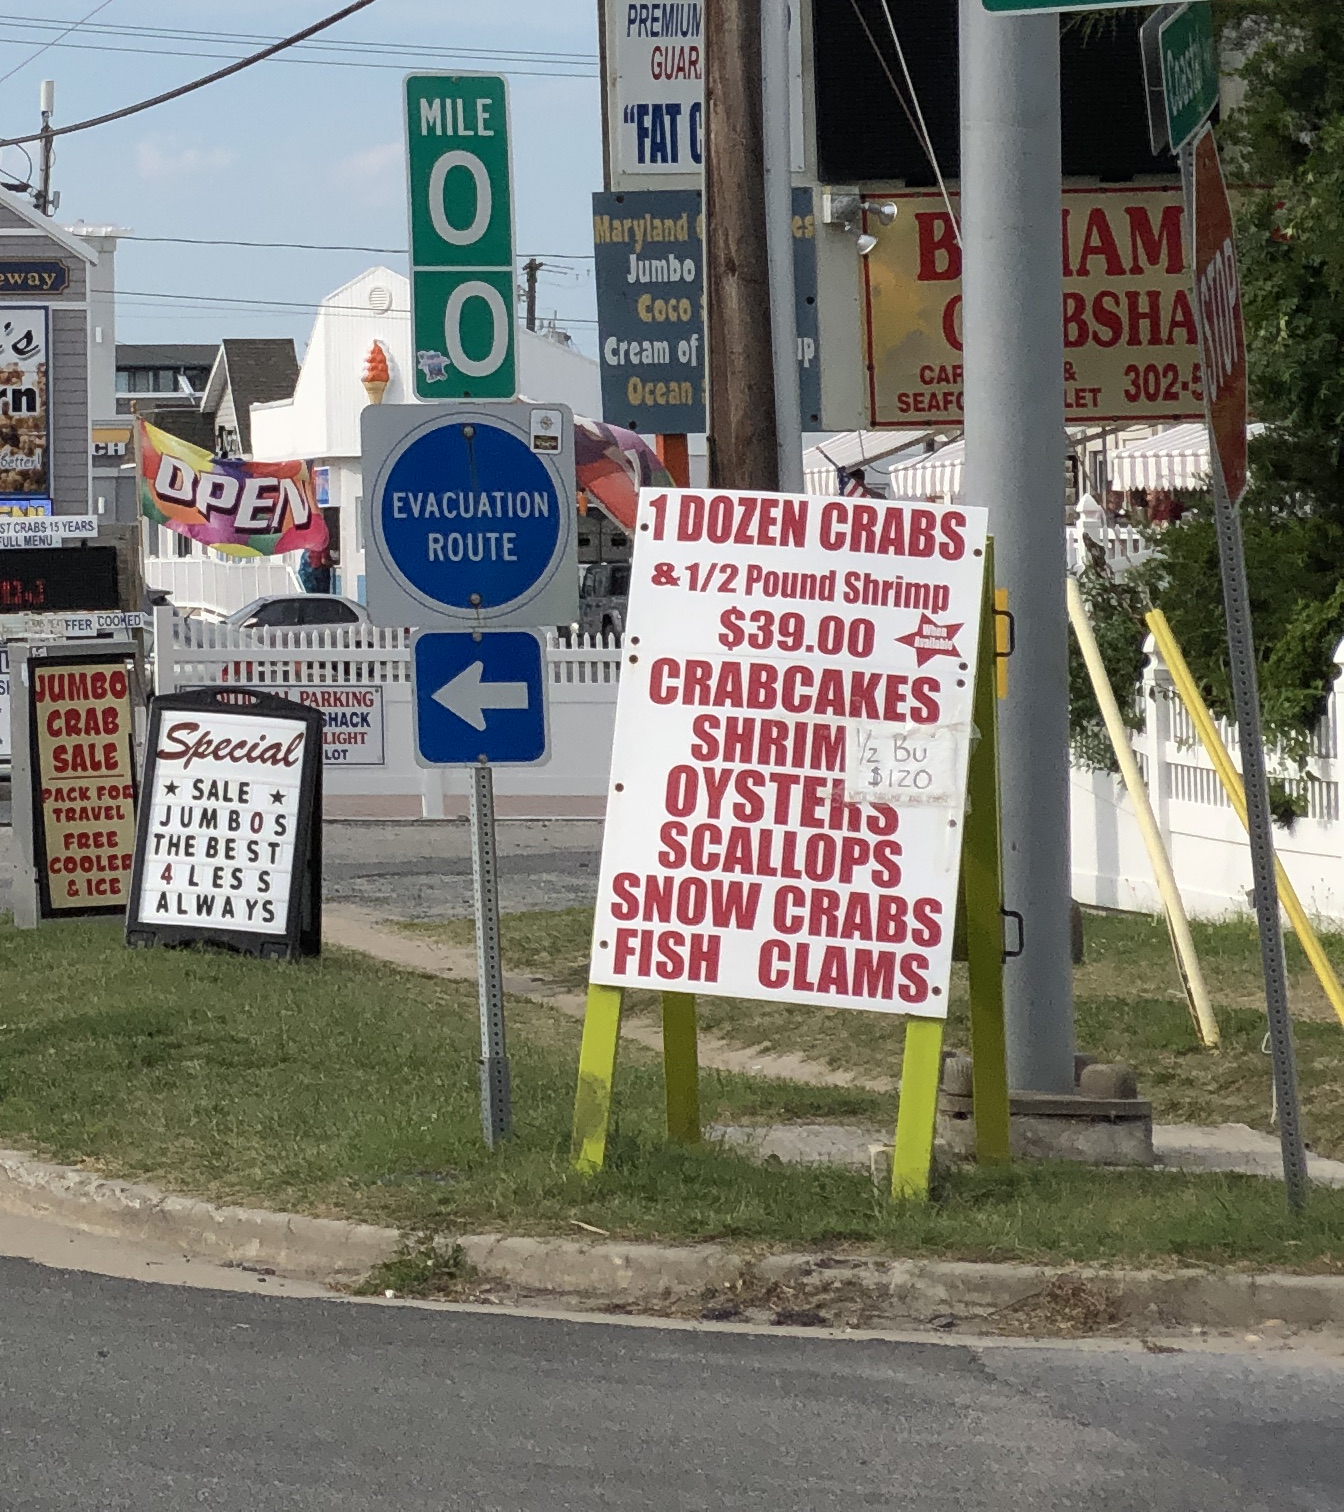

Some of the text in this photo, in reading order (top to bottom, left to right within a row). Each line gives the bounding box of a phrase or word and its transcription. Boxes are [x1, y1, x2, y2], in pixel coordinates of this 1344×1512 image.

[650, 45, 703, 81] GUAR
[418, 97, 495, 137] MILE
[428, 149, 493, 247] 0
[593, 212, 689, 254] Maryland
[627, 253, 696, 284] Jumbo
[637, 293, 692, 323] Coco
[1200, 237, 1239, 403] STOP
[444, 279, 509, 378] 0
[603, 333, 699, 367] Cream of
[626, 375, 693, 407] Ocean
[155, 453, 311, 532] OPEN
[392, 490, 550, 520] EVACUATION
[13, 521, 47, 534] CRABS
[49, 521, 60, 533] 15
[61, 519, 95, 533] YEARS
[23, 534, 53, 547] MENU
[647, 493, 968, 563] 1 DOZEN CRABS
[427, 531, 519, 563] ROUTE
[649, 562, 951, 615] & 1/2 Pound Shrimp
[64, 619, 93, 632] FFER
[717, 605, 876, 659] $39.00
[35, 669, 128, 704] JUMBO
[299, 690, 374, 708] PARKING
[647, 656, 942, 726] CRABCAKES
[46, 706, 120, 738] CRAB
[322, 731, 368, 745] LIGHT
[52, 742, 119, 774] SALE
[155, 721, 305, 770] Special
[324, 749, 349, 761] LOT
[689, 713, 847, 774] SHRIM
[41, 783, 135, 805] PACK FOR
[191, 777, 251, 804] SALE
[867, 766, 933, 790] $120
[52, 804, 126, 824] TRAVEL
[158, 804, 288, 838] JUMBOS
[63, 830, 119, 851] FREE
[153, 832, 281, 865] THE BEST
[657, 820, 904, 890] SCALLOPS
[49, 853, 133, 875] COOLER
[160, 862, 271, 894] 4 LESS
[66, 877, 122, 898] & ICE
[155, 890, 276, 924] ALWAYS
[610, 871, 944, 949] SNOW CRABS
[611, 926, 931, 1005] FISH CLAMS
